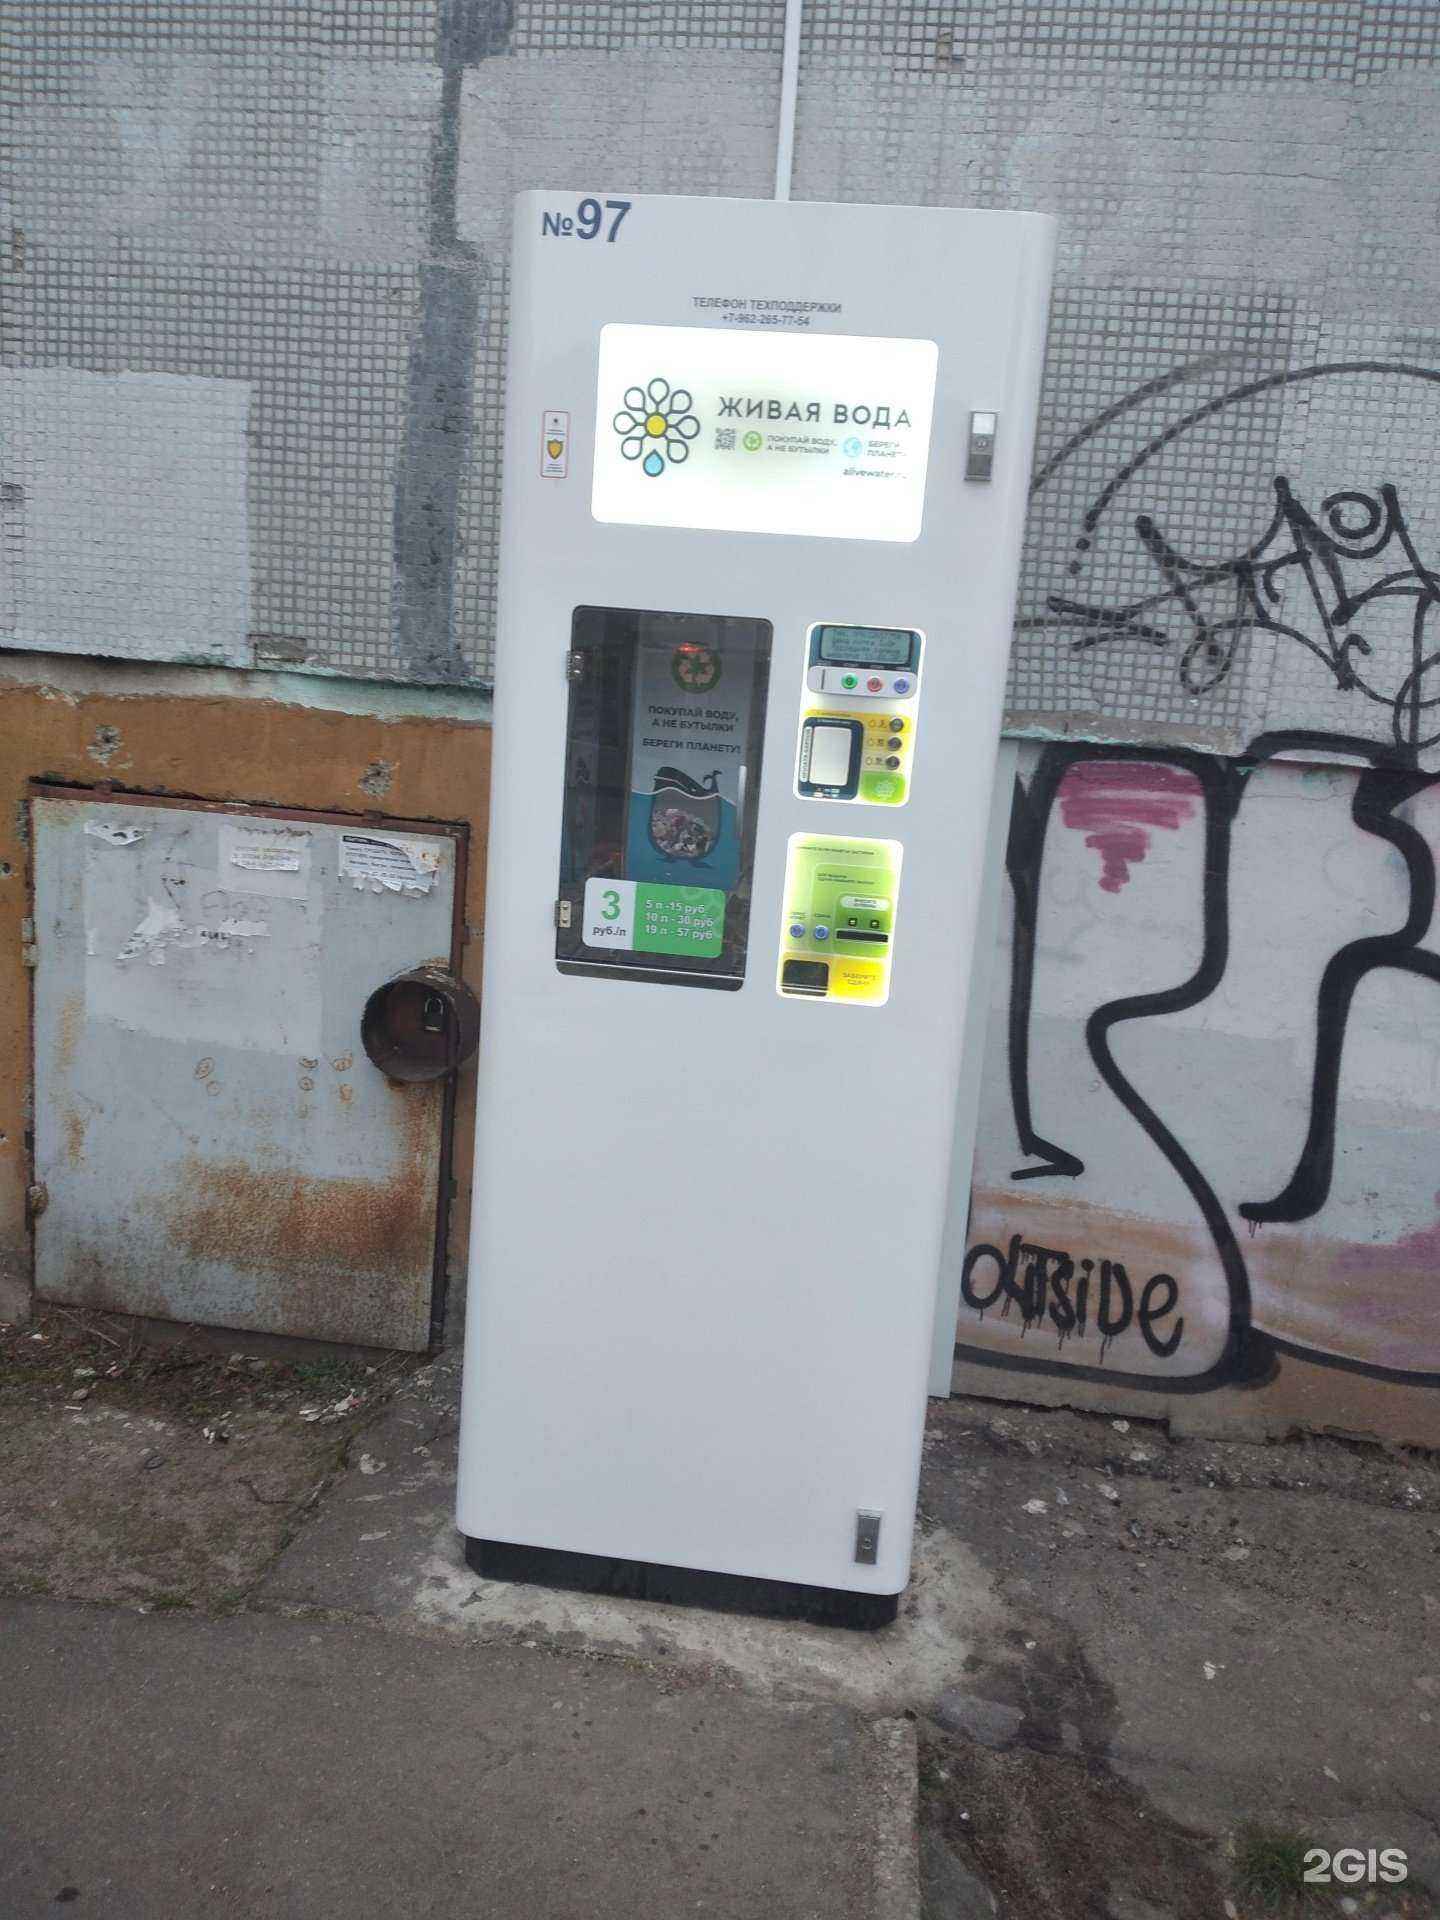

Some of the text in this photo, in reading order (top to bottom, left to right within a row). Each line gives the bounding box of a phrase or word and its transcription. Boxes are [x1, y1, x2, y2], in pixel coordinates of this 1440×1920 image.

[542, 198, 632, 243] №97
[693, 297, 842, 313] ТЕЛЕФОН ТЕХПОДДЕРЖКИ
[717, 396, 912, 430] ЖИВАЯ ВОДА
[648, 705, 739, 722] ПОКУПАЙ ВОДУ,
[652, 719, 734, 732] А НЕ БУТЫЛКИ
[642, 738, 684, 749] БЕРЕГИ
[601, 890, 621, 920] 3
[645, 900, 653, 909] 5
[684, 904, 705, 914] руб
[645, 912, 658, 922] 10
[692, 917, 714, 928] руб
[645, 924, 657, 935] 19
[677, 927, 689, 937] 57
[692, 930, 713, 941] руб
